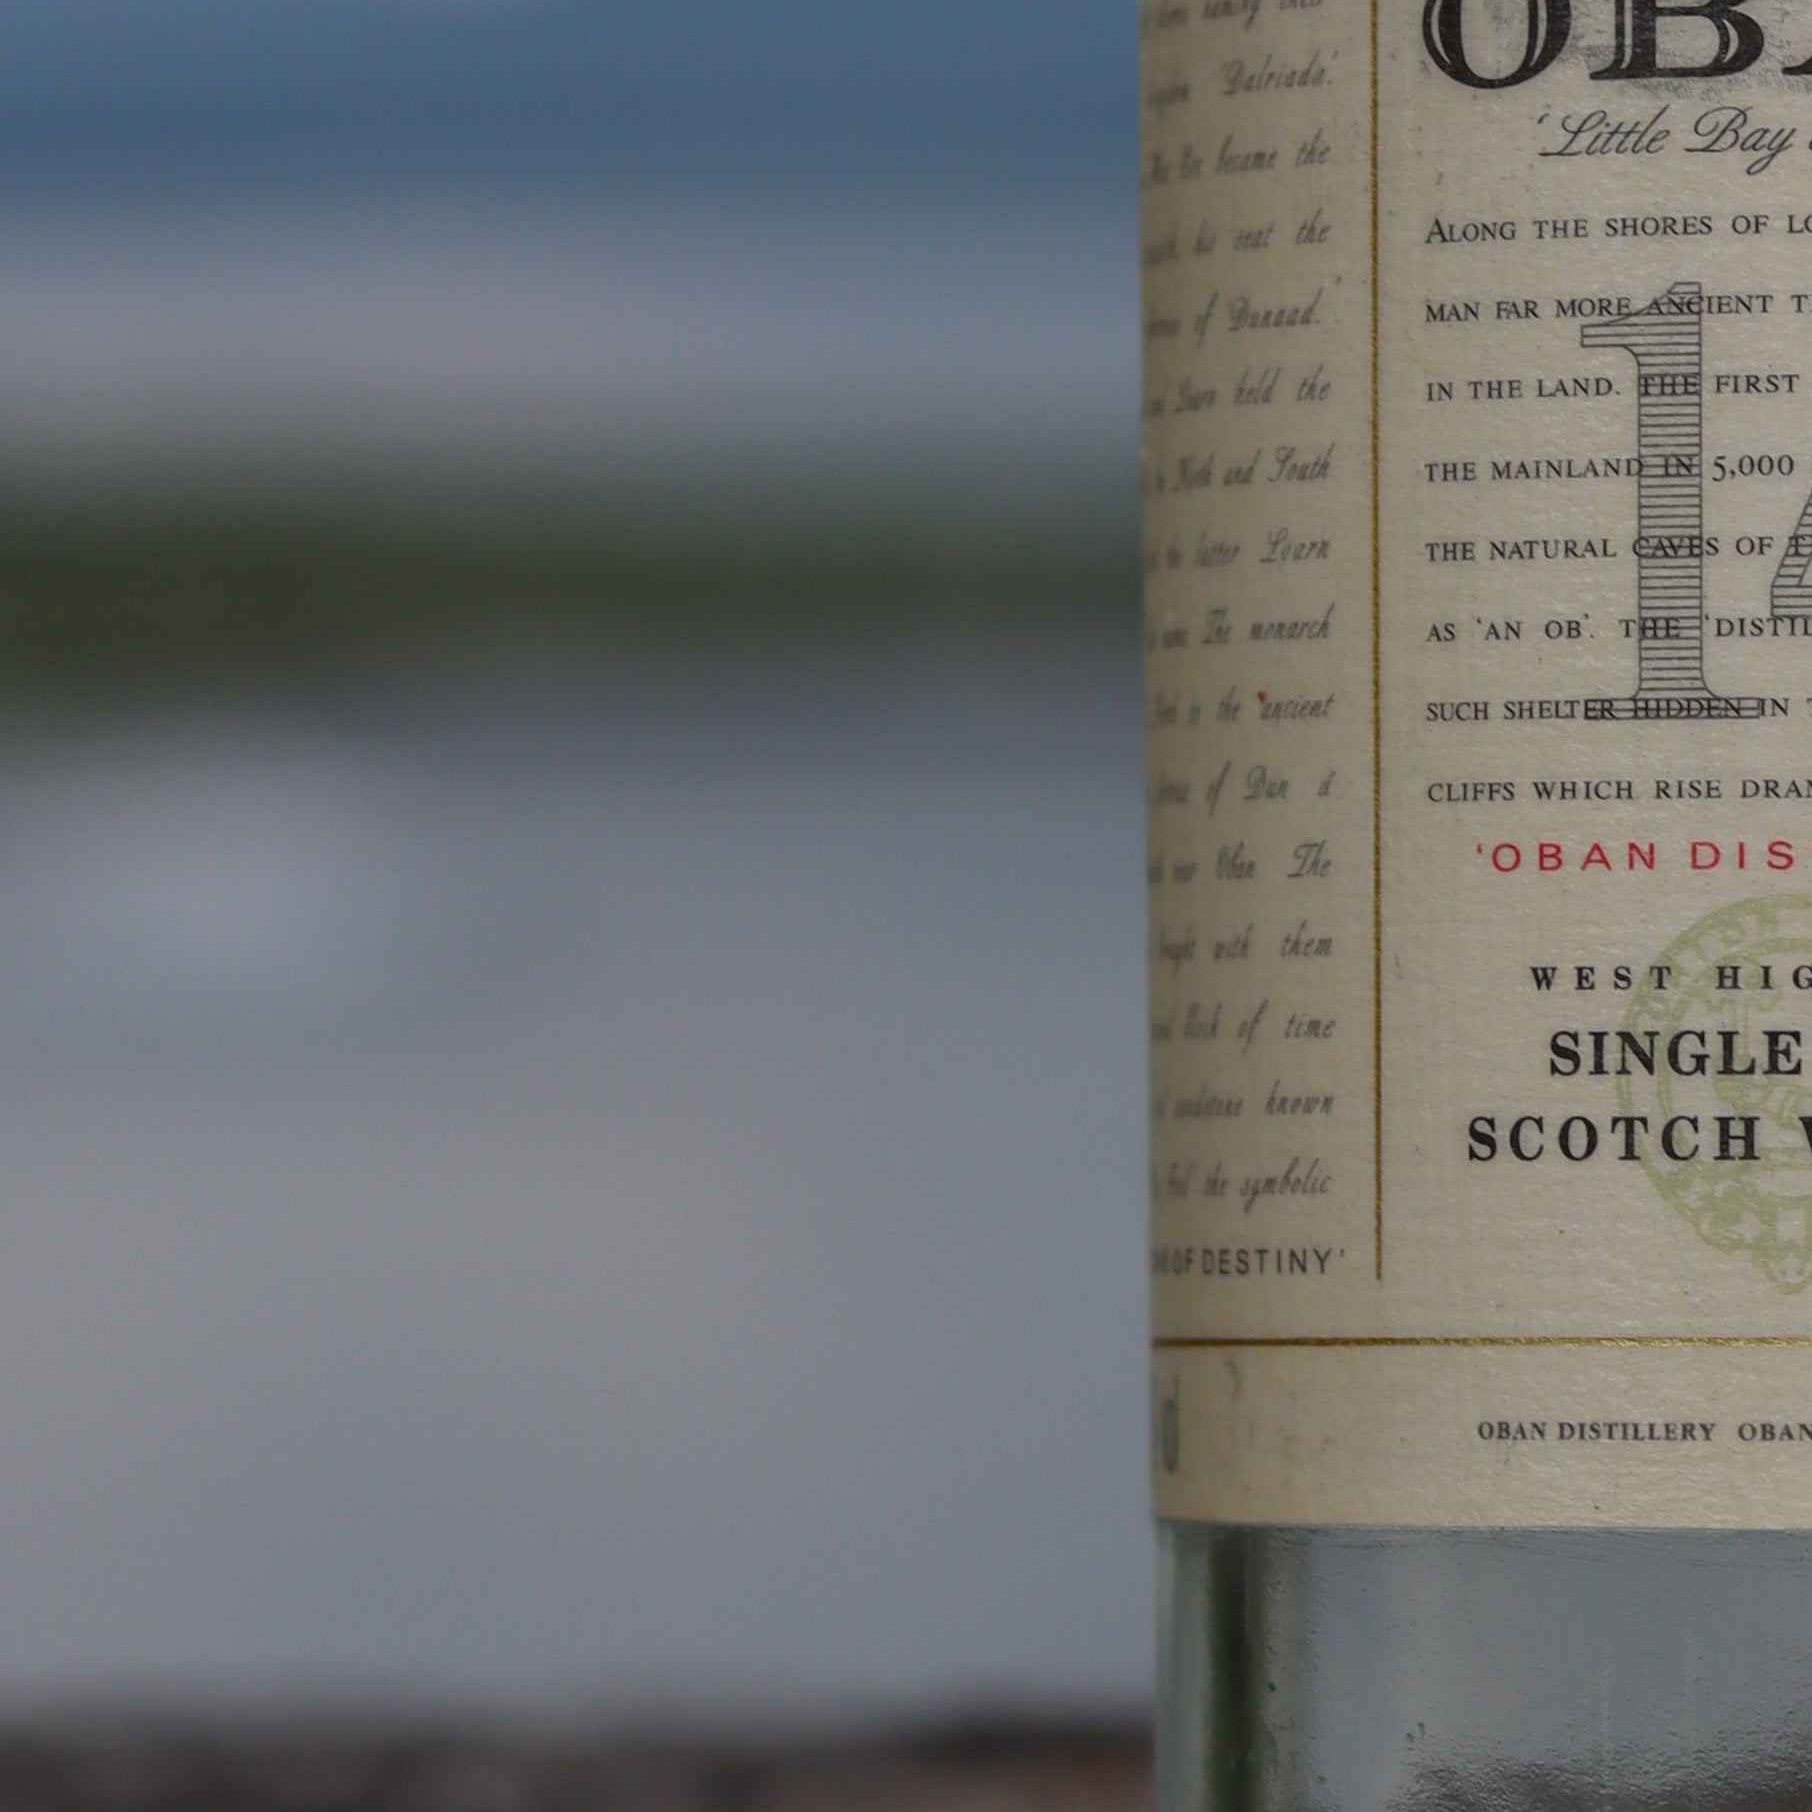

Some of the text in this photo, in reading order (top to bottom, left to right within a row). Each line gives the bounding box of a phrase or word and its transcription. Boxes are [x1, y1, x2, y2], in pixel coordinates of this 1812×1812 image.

[1295, 128, 1331, 167] the
[1685, 106, 1794, 175] Bay
[1426, 218, 1516, 244] ALONG
[1532, 220, 1588, 238] THE
[1605, 217, 1713, 236] SHORES
[1731, 215, 1770, 234] OF
[1426, 302, 1480, 323] MAN
[1496, 301, 1539, 319] FAR
[1556, 298, 1630, 317] MORE
[1648, 295, 1774, 315] ANCIENT
[1296, 365, 1331, 402] the
[1427, 382, 1453, 401] IN
[1468, 380, 1523, 398] THE
[1537, 378, 1621, 397] LAND.
[1640, 376, 1700, 395] THE
[1715, 375, 1799, 393] FIRST
[1426, 462, 1476, 482] THE
[1491, 459, 1642, 479] MAINLAND
[1663, 456, 1694, 475] IN
[1712, 455, 1794, 482] 5,000
[1426, 542, 1475, 561] THE
[1490, 539, 1617, 560] NATURAL
[1633, 537, 1719, 557] CAVES
[1736, 536, 1773, 555] OF
[1428, 622, 1456, 642] AS
[1477, 618, 1521, 640] 'AN
[1619, 619, 1680, 638] THE
[1426, 701, 1489, 721] SUCH
[1504, 700, 1616, 719] SHELTER
[1634, 699, 1742, 718] HIDDEN
[1759, 698, 1789, 717] IN
[1428, 782, 1514, 802] CLIFFS
[1533, 781, 1633, 800] WHICH
[1655, 780, 1722, 799] RISE
[1287, 839, 1332, 878] The
[1477, 842, 1656, 872] 'OBAN
[1280, 920, 1333, 958] them
[1530, 967, 1672, 990] WEST
[1550, 1030, 1802, 1076] SINGLE
[1468, 1116, 1761, 1161] SCOTCH
[1478, 1422, 1548, 1441] OBAN
[1557, 1422, 1718, 1441] DISTILLERY
